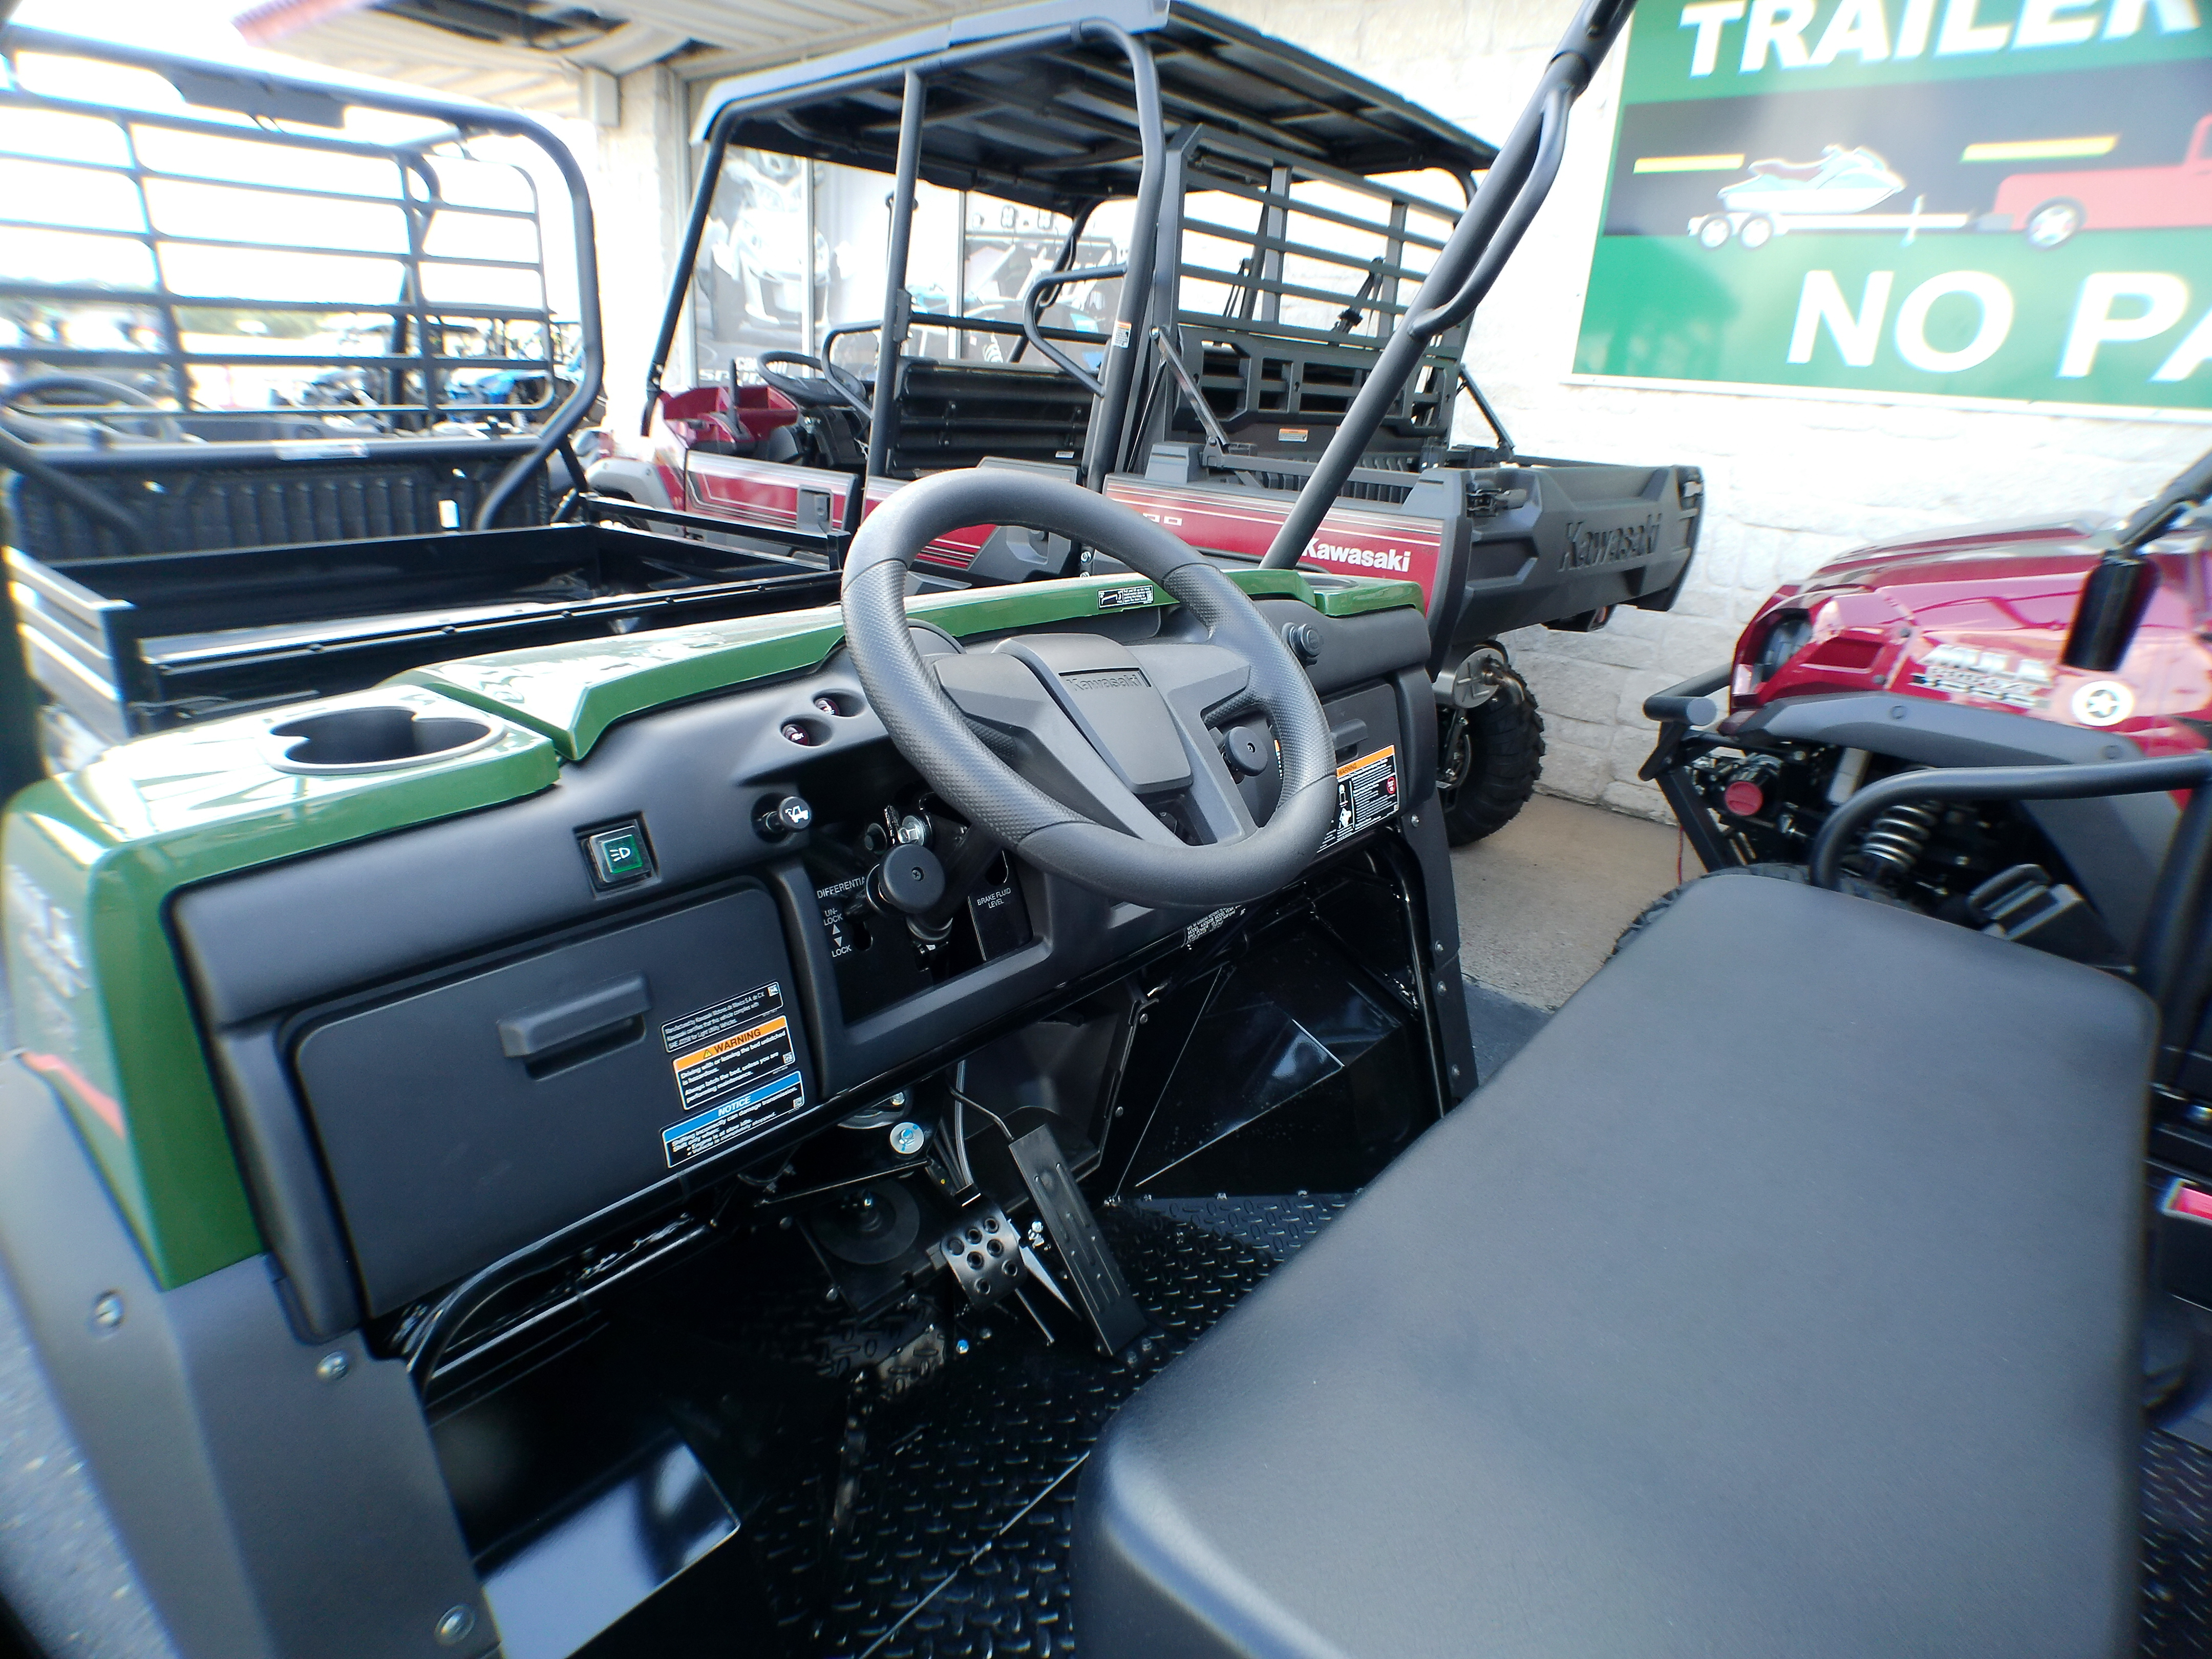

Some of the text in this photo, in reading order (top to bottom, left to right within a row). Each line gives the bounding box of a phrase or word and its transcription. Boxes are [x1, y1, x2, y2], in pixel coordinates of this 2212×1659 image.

[1785, 270, 2014, 373] NO
[1557, 513, 1663, 572] Kawasaki
[1302, 538, 1411, 572] Kawasaki
[1066, 674, 1142, 691] Kawasaki
[977, 888, 1011, 906] BRAKE FLUID
[988, 899, 1004, 908] LEVEL
[823, 913, 843, 926] LOCK
[824, 908, 838, 917] UN-
[831, 945, 852, 958] LOCK
[713, 1028, 761, 1053] WARNING
[718, 1095, 751, 1116] NOTICE
